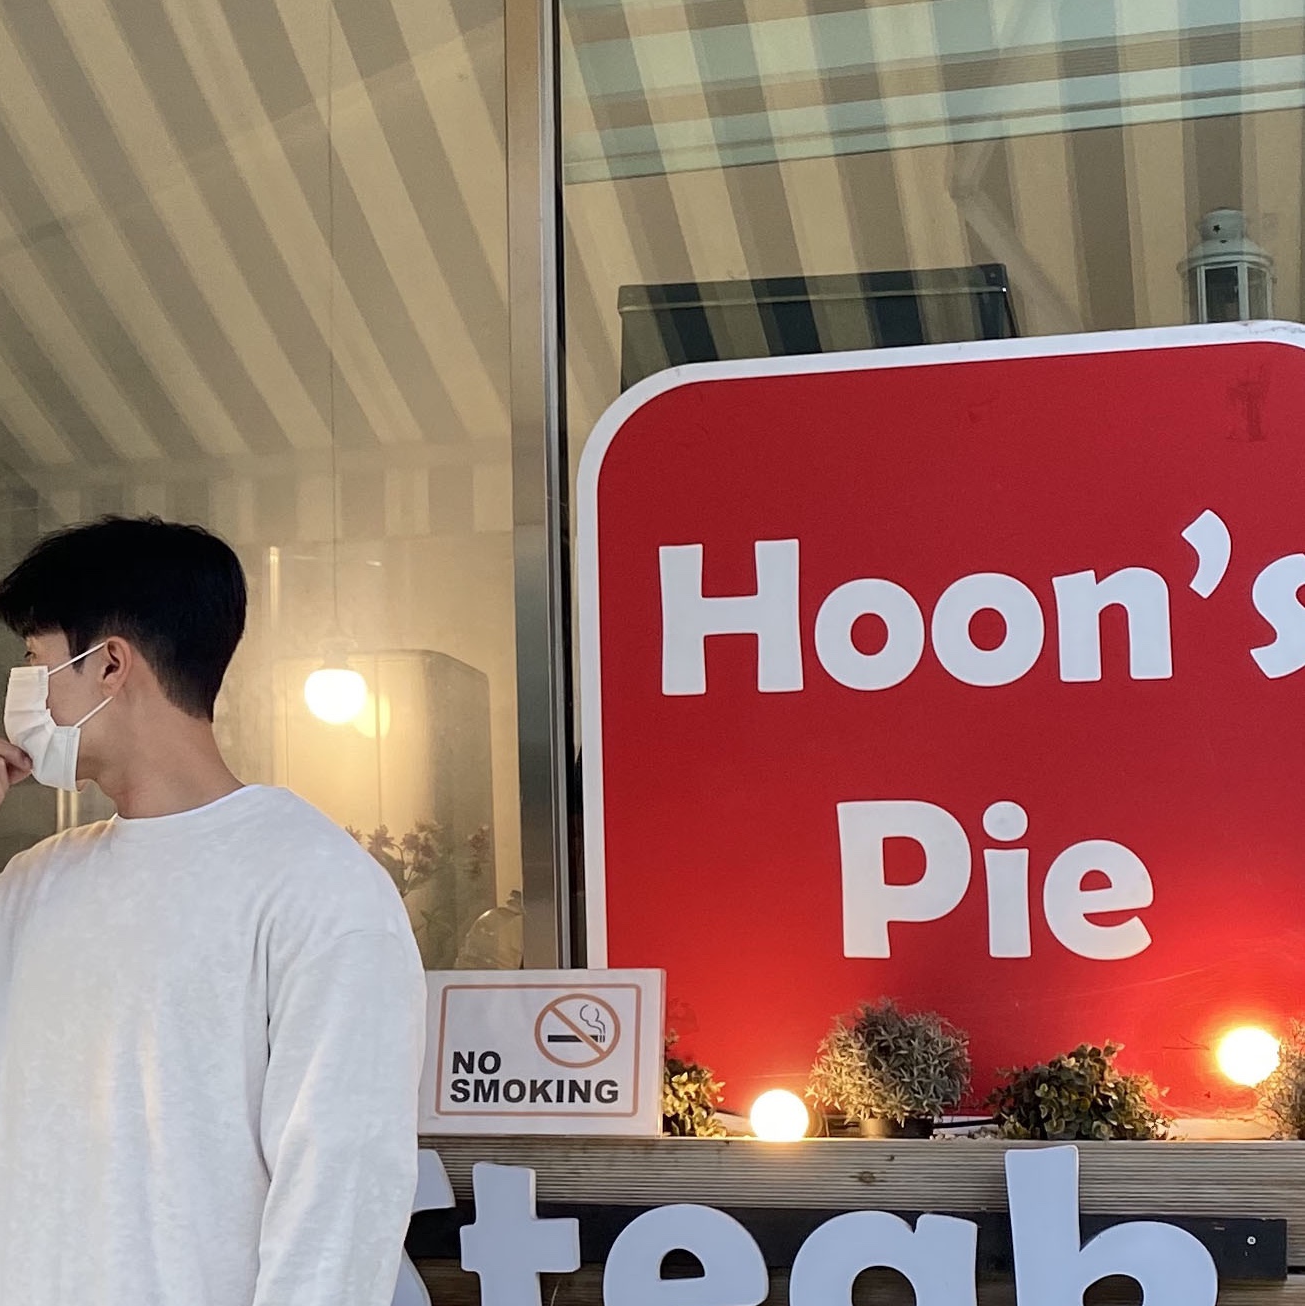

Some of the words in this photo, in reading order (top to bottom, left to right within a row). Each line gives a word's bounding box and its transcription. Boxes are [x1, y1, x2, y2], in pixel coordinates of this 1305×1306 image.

[836, 800, 1154, 960] Pie
[452, 1051, 502, 1075] NO
[449, 1079, 619, 1103] SMOKING
